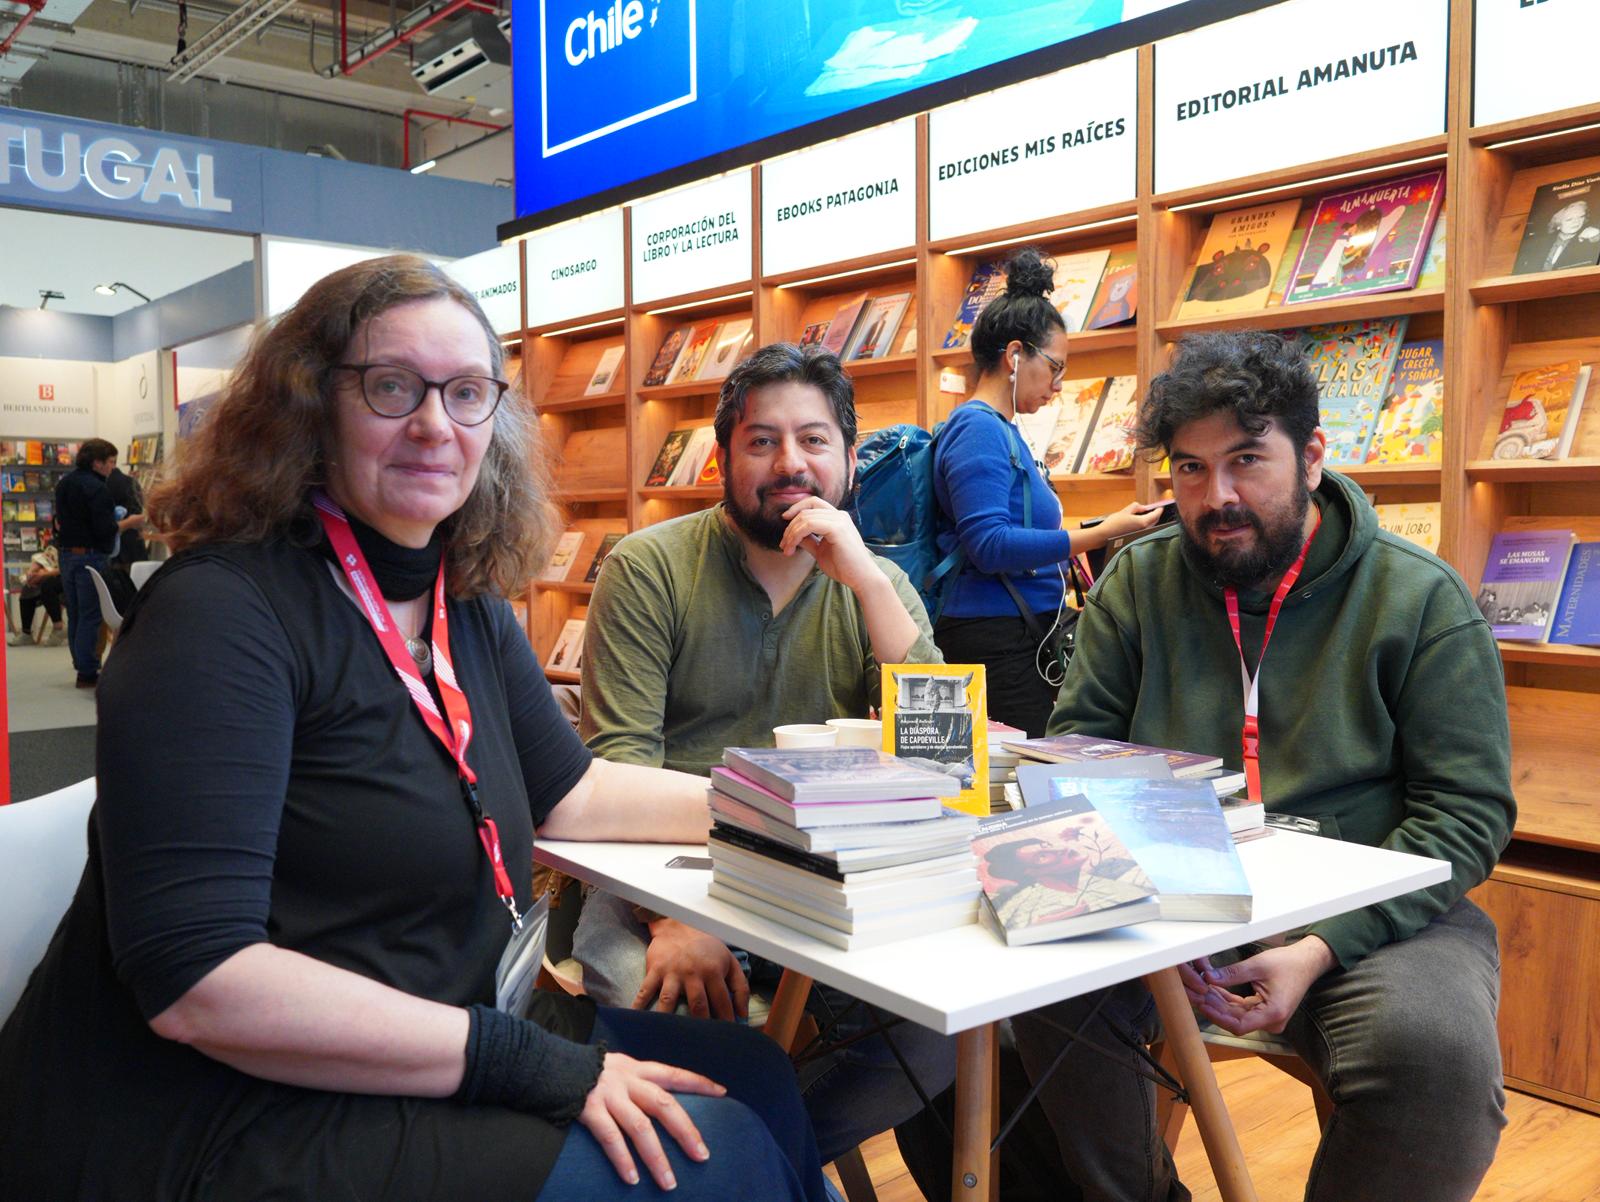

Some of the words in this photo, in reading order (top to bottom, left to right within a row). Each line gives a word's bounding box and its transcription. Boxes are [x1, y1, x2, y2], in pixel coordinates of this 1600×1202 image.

[564, 0, 645, 67] Chile
[1177, 76, 1289, 121] EDITORIAL
[1297, 40, 1418, 90] AMANUTA
[938, 146, 1019, 181] EDICIONES
[1025, 136, 1055, 158] MIS
[1062, 117, 1126, 150] RAÍCES
[777, 198, 823, 222] EBOOKS
[826, 177, 899, 209] PATAGONIA
[1230, 210, 1276, 225] GRANDES
[647, 215, 715, 246] CORPORACIÓN
[718, 211, 736, 226] DEL
[1231, 220, 1269, 234] AMIGOS
[643, 243, 670, 263] LIBRO
[672, 242, 679, 255] Y
[681, 239, 693, 253] LA
[696, 227, 739, 249] LECTURA
[551, 258, 597, 281] CINOSARGO
[480, 280, 517, 299] ANIMADOS
[1403, 357, 1435, 370] CRECER
[1400, 371, 1407, 380] Y
[1408, 368, 1440, 381] SOÑAR
[3, 403, 51, 414] BERTRAND
[52, 405, 89, 415] EDITORA
[1405, 522, 1432, 536] LOBO
[1509, 556, 1551, 565] EMANCIPAN
[1522, 550, 1546, 558] MUSAS
[900, 727, 909, 735] LA
[900, 736, 909, 744] DE
[910, 736, 945, 744] CAPDEVILLE
